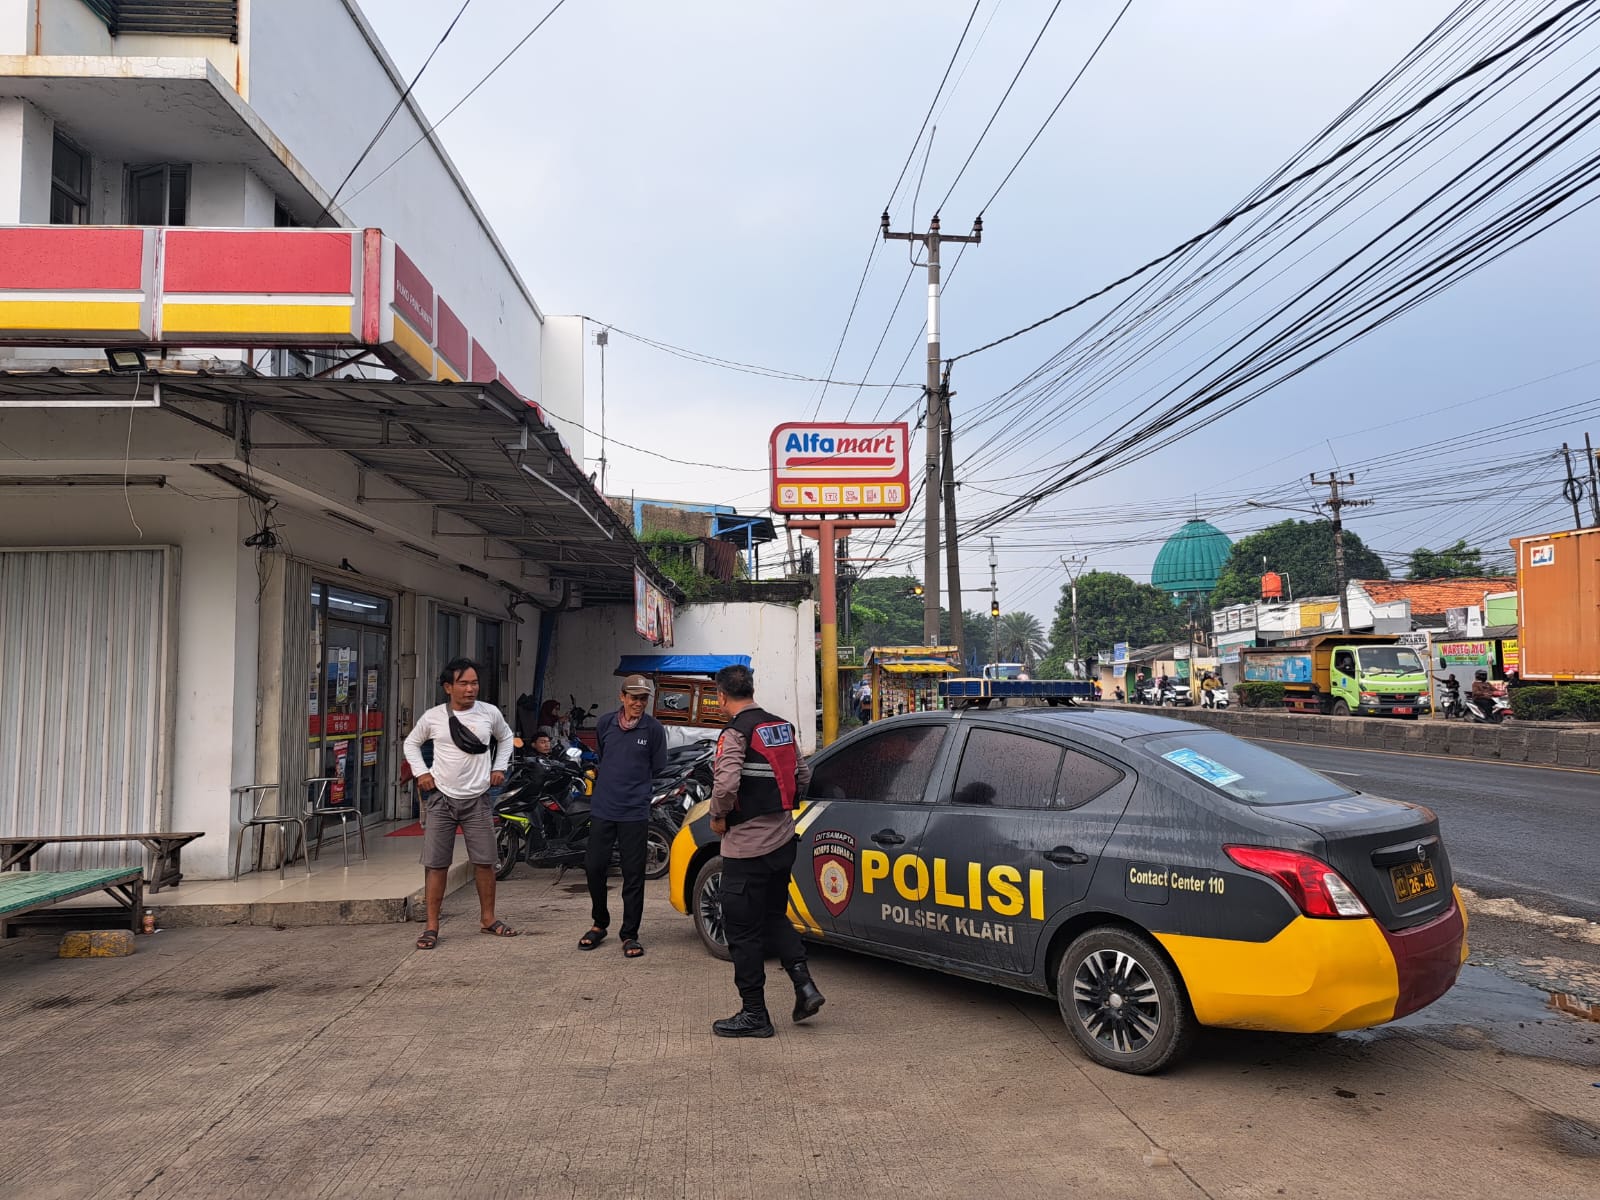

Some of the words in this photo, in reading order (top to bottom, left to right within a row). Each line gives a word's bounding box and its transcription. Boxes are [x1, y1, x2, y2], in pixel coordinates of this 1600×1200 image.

[785, 433, 895, 453] Alfamart
[861, 849, 1045, 921] POLISI
[1129, 867, 1168, 887] Contact
[1171, 872, 1205, 892] Center
[1208, 876, 1224, 894] 110
[881, 903, 950, 932] POLSEK
[955, 916, 1013, 945] KLARI
